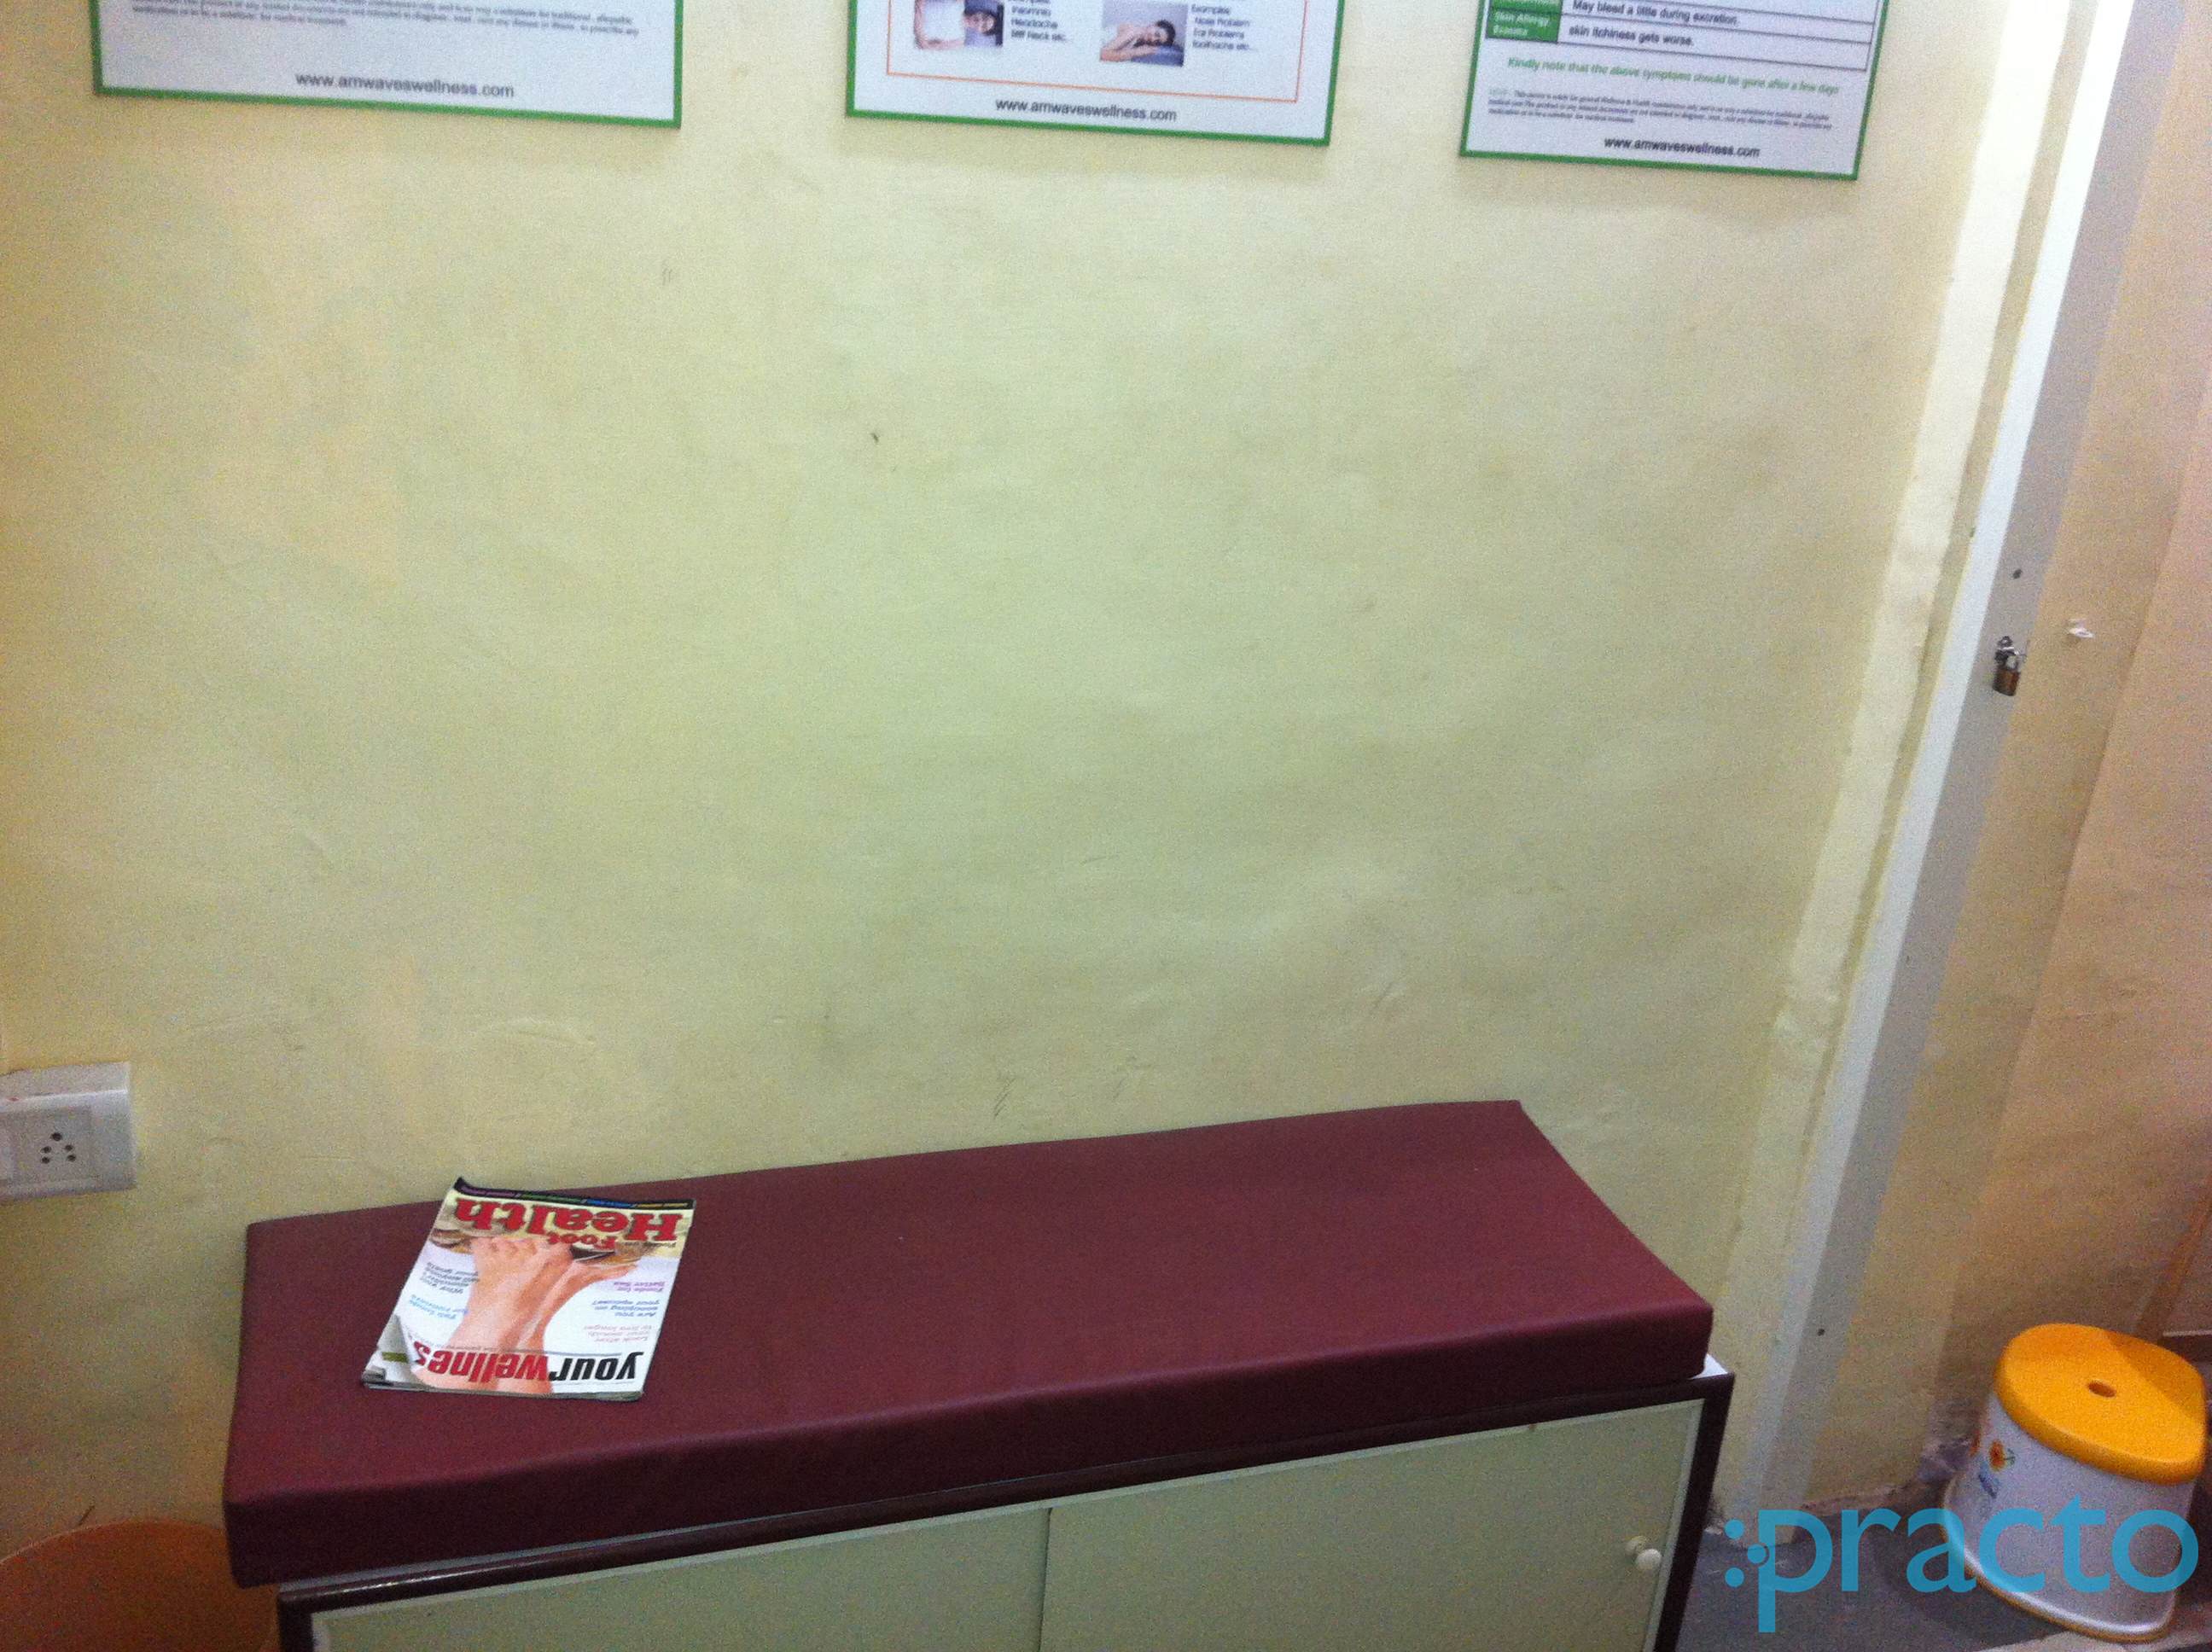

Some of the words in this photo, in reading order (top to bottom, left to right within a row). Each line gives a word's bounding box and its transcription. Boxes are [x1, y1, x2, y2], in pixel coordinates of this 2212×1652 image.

[1572, 1, 1593, 13] May
[1597, 2, 1624, 15] bleed
[1637, 6, 1657, 17] little
[1660, 8, 1691, 22] during
[1569, 25, 1589, 37] skin
[1592, 26, 1636, 41] itchiness
[1639, 32, 1660, 44] gets
[1508, 57, 1539, 72] Kindly
[1542, 61, 1565, 71] note
[1569, 61, 1589, 73] that
[1591, 64, 1609, 74] the
[294, 73, 515, 97] www.amwaveswellness.com
[995, 99, 1177, 122] www.amwaveswellness.com
[1604, 137, 1761, 158] www.amwaveswellness.com
[454, 1198, 684, 1242] Health
[547, 1233, 616, 1252] Foot
